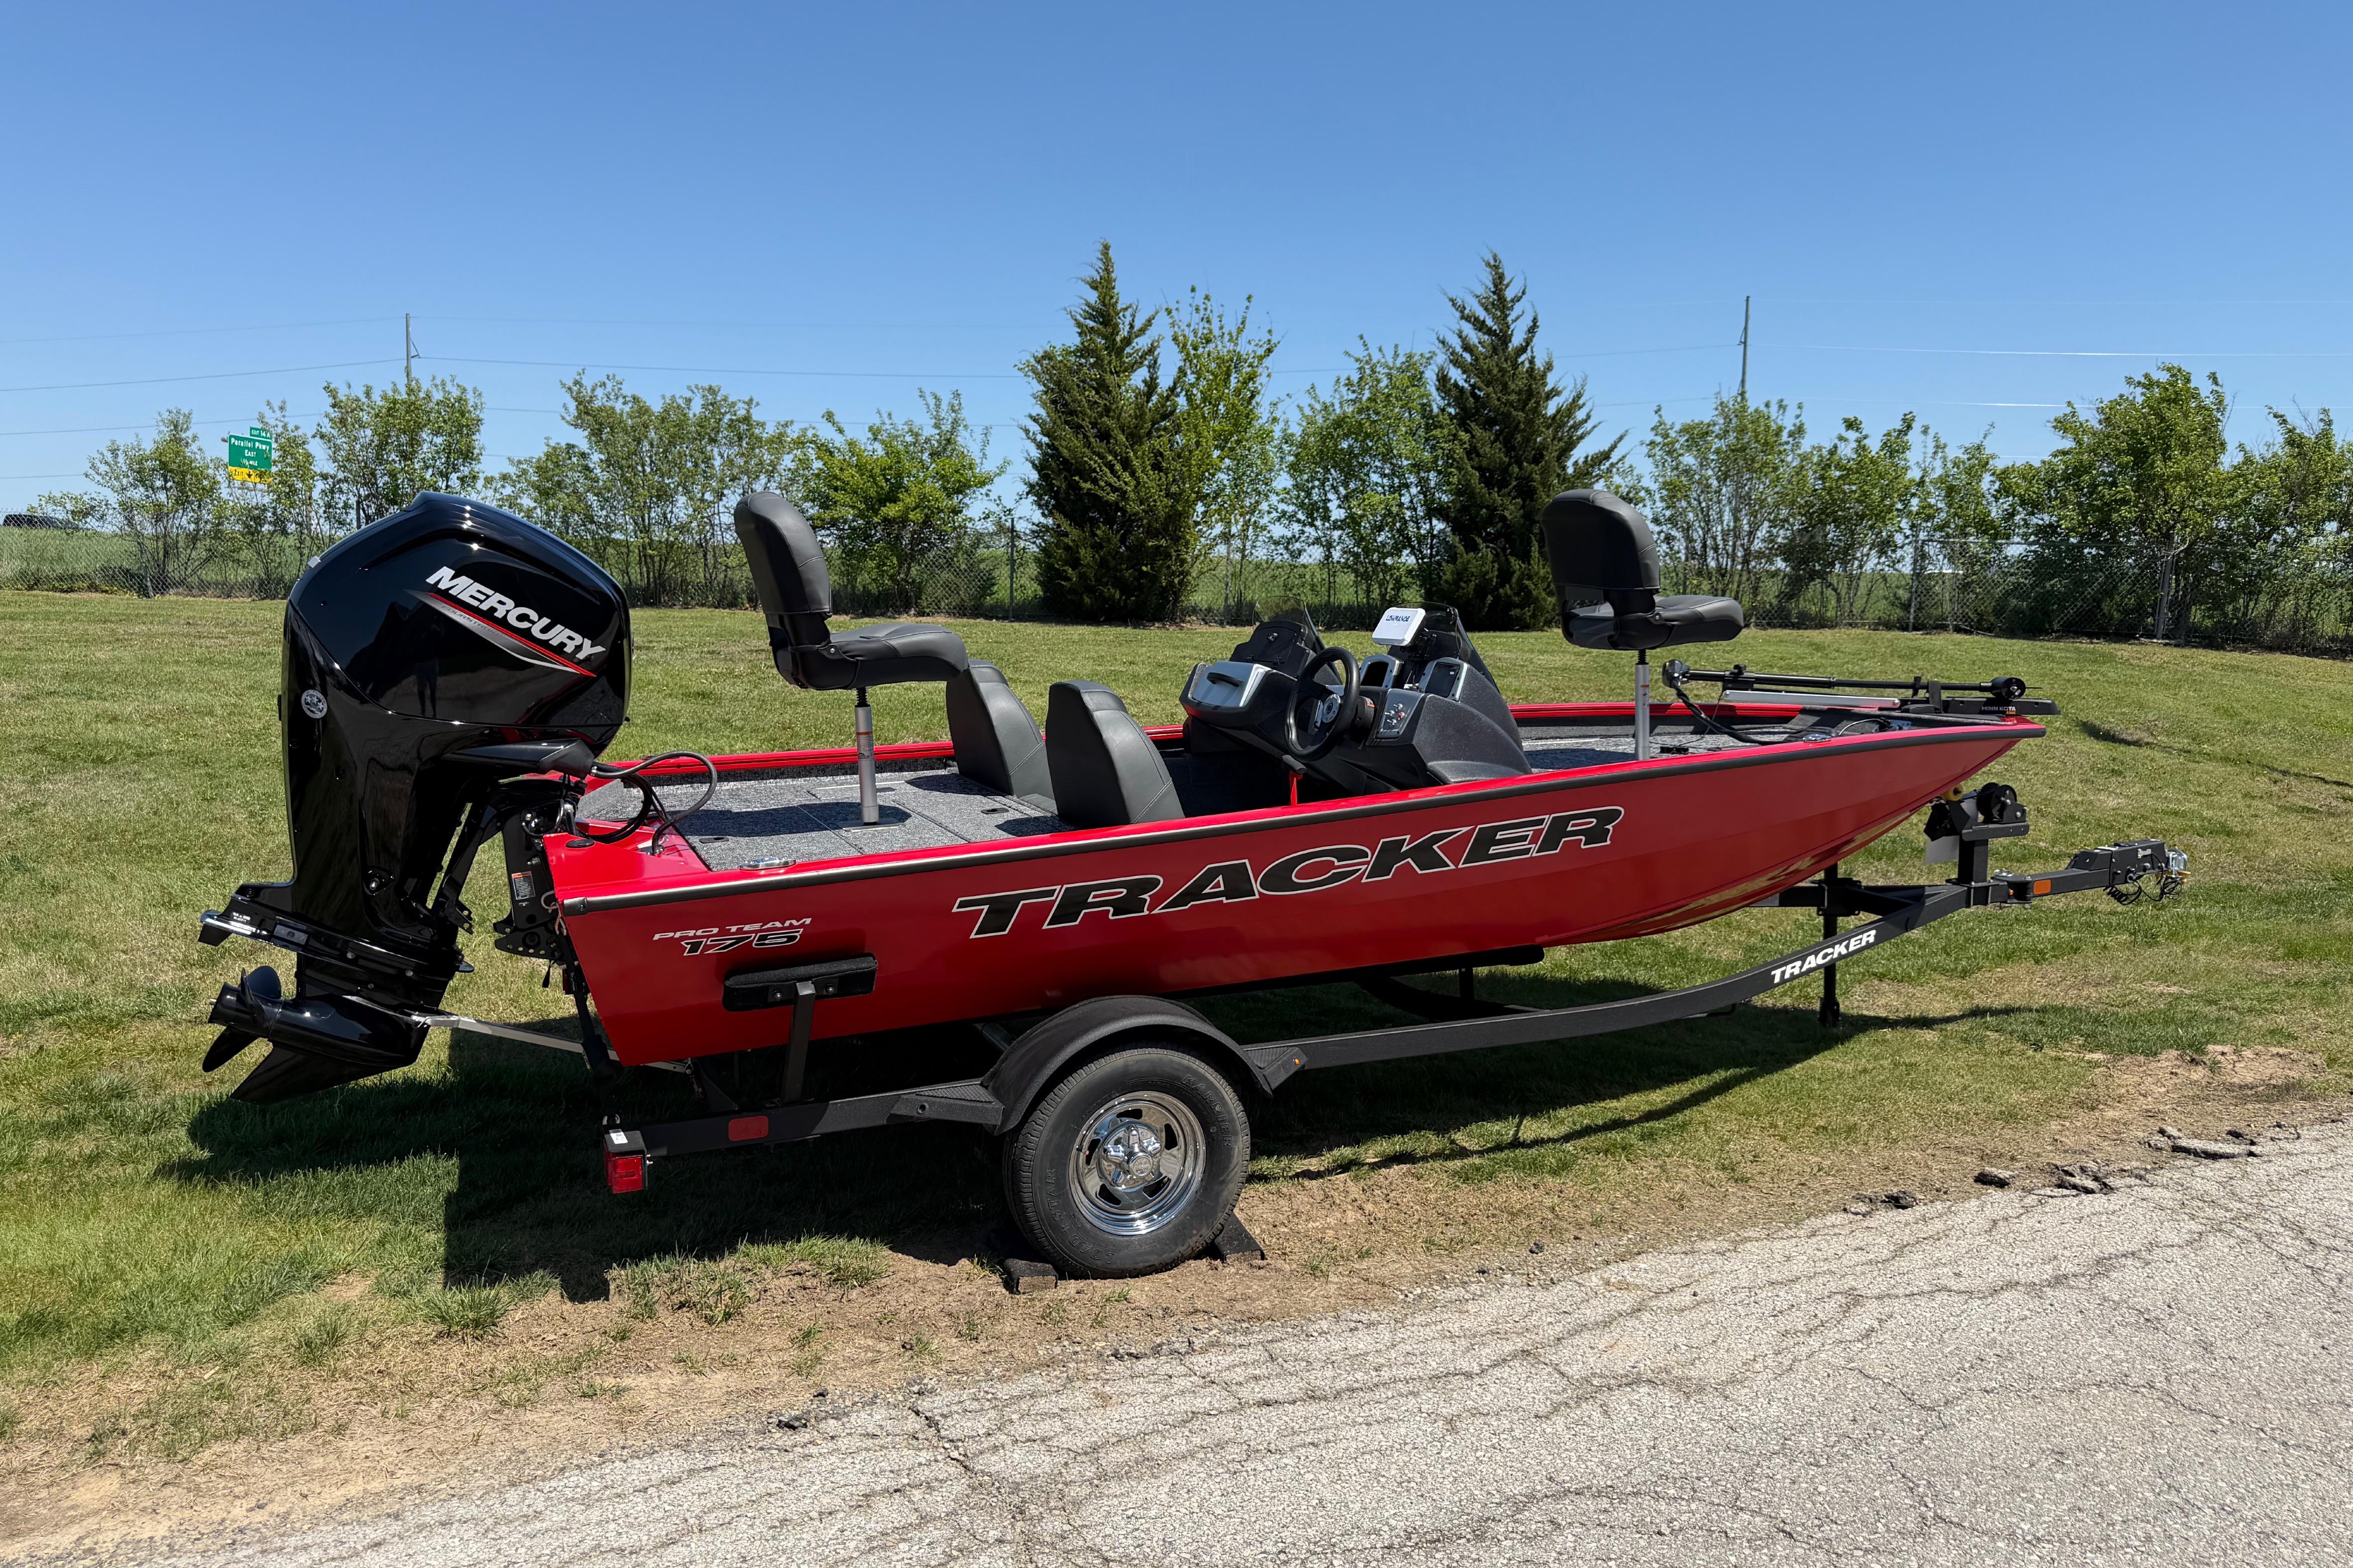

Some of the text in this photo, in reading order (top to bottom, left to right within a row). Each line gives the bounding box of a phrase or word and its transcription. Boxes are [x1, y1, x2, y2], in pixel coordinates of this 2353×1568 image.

[231, 437, 269, 452] Parallel Pkwy
[245, 449, 256, 458] EAST
[425, 566, 606, 660] MERCURY
[952, 806, 1625, 938] TRACKER
[653, 918, 812, 940] PRO TEAM
[680, 928, 804, 956] 175
[1771, 929, 1876, 983] TRACKER
[1182, 1074, 1233, 1147] KARRIER
[1046, 1169, 1063, 1221] STAR
